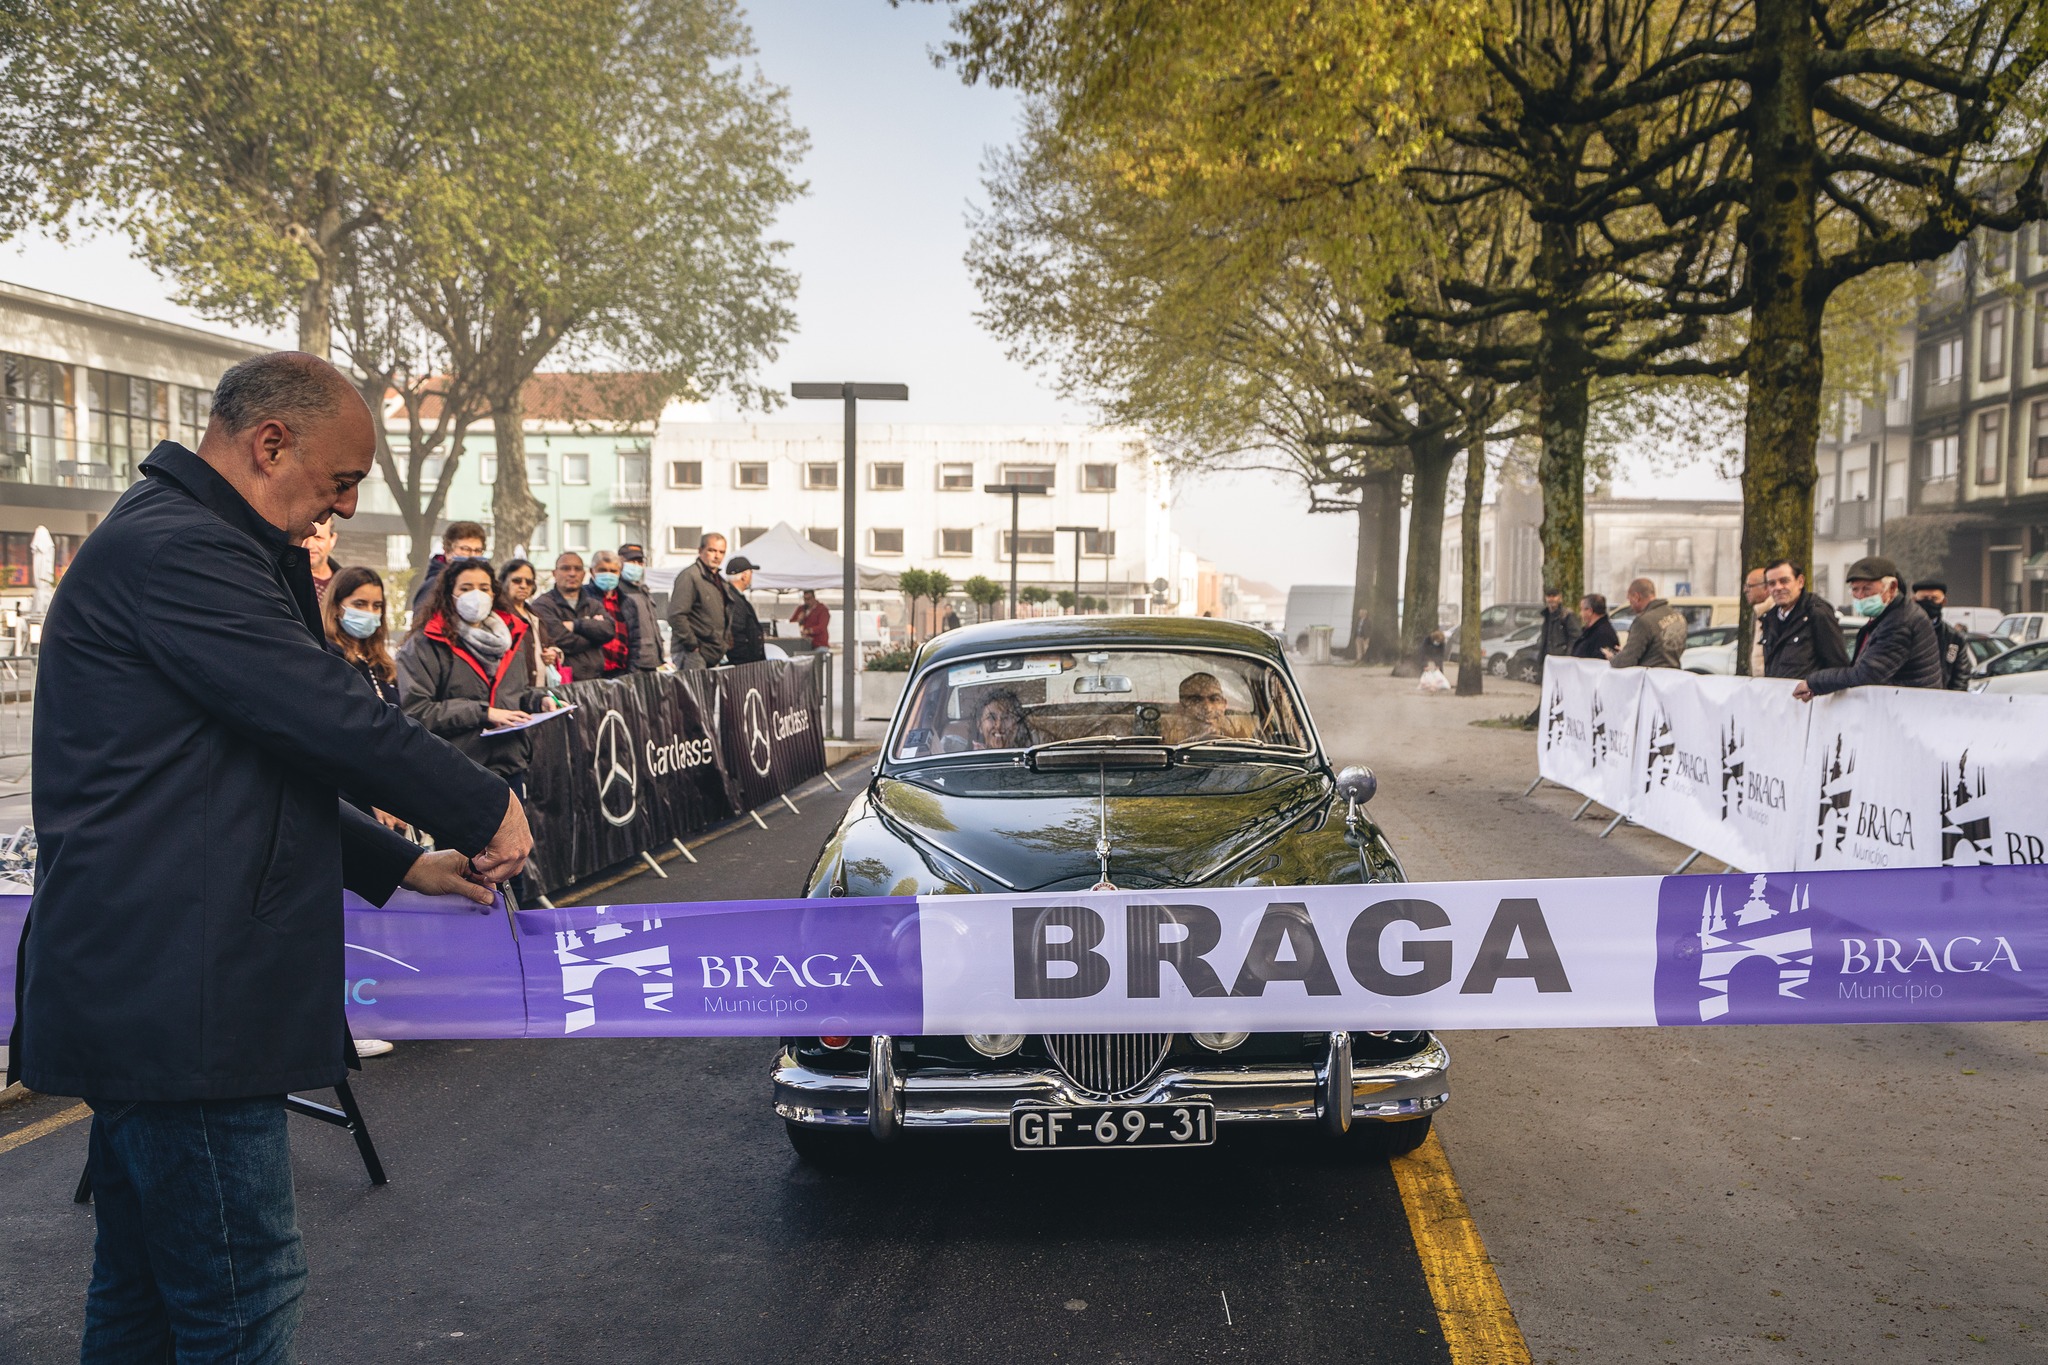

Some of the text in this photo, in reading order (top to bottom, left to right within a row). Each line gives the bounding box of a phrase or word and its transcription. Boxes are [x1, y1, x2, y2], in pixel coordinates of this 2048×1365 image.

[646, 734, 712, 777] Carclasse
[1748, 771, 1785, 811] BRAGA
[1857, 802, 1914, 850] BRAGA
[1012, 898, 1572, 999] BRAGA
[1839, 936, 2022, 974] BRAGA
[697, 954, 883, 989] BRAGA
[704, 993, 808, 1016] Município
[1838, 979, 1943, 1004] Município
[1019, 1108, 1207, 1146] GF-69-31
